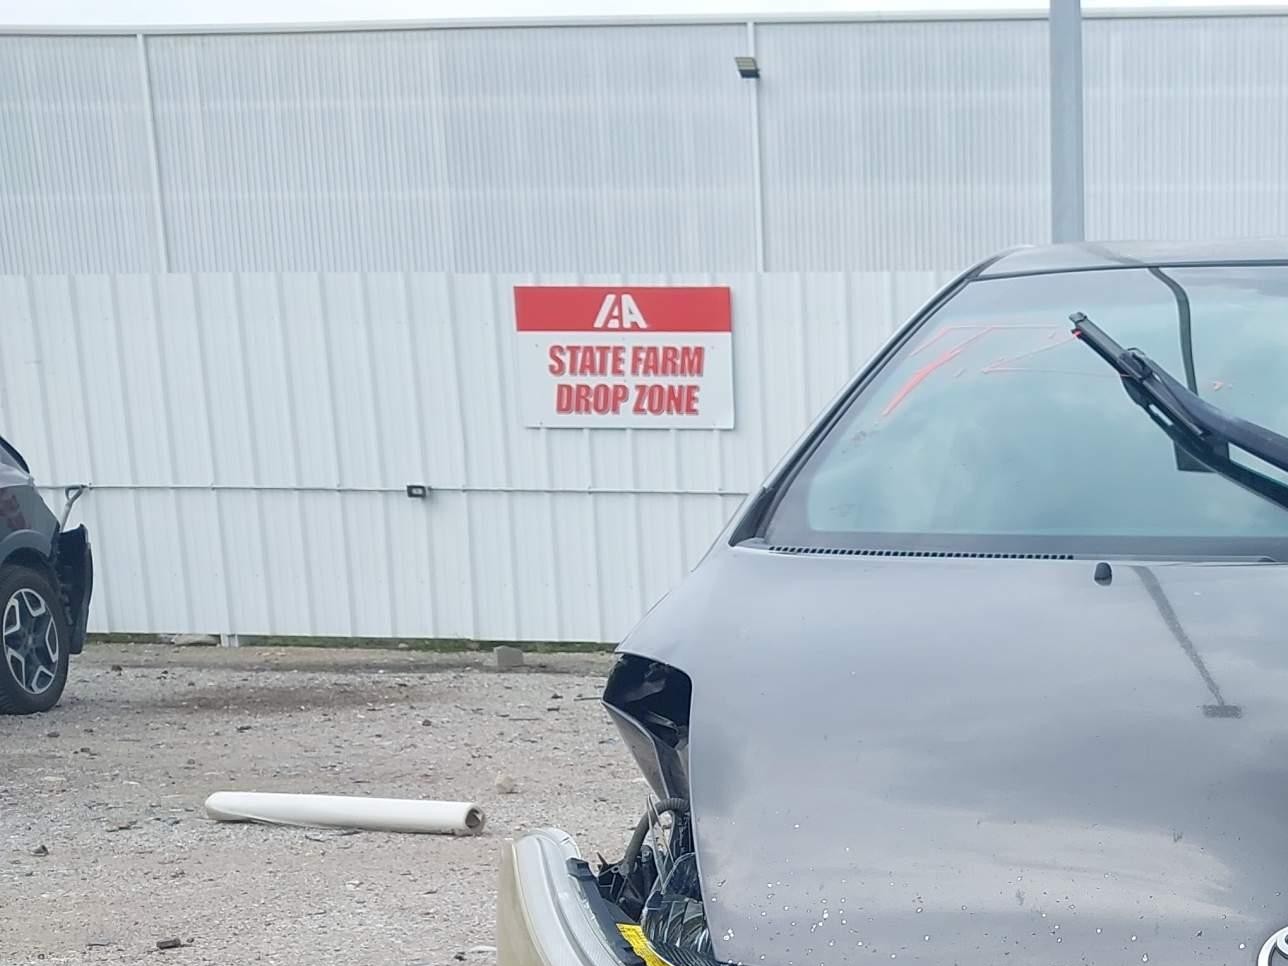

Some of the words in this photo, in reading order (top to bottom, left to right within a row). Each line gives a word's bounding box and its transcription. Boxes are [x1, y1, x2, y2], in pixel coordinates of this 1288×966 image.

[548, 345, 624, 377] STATE
[630, 346, 705, 377] FARM
[556, 384, 629, 415] DROP
[632, 385, 700, 415] ZONE
